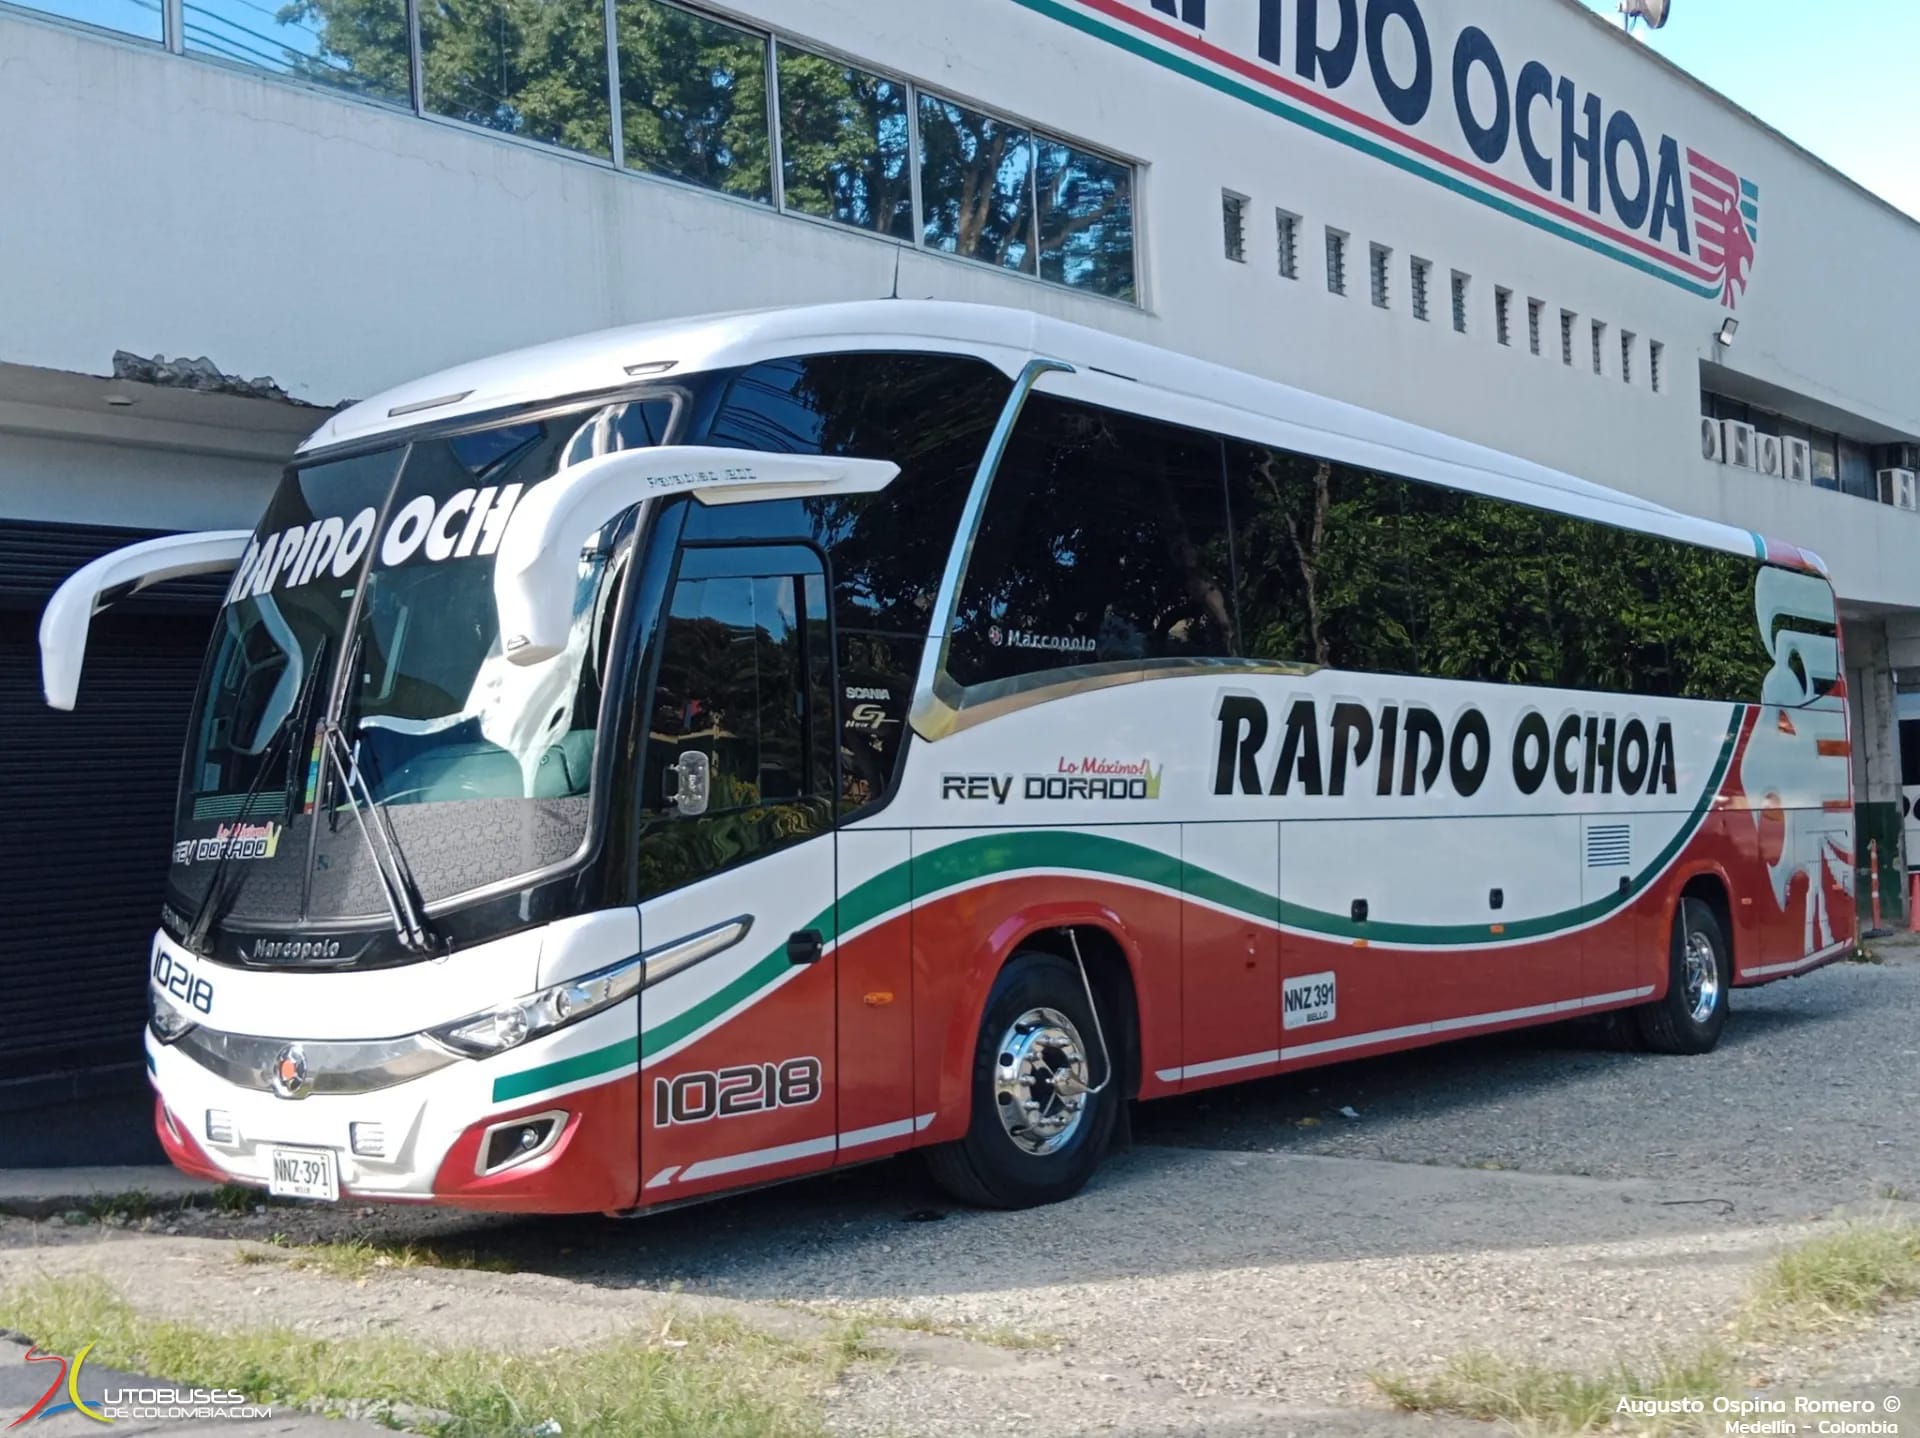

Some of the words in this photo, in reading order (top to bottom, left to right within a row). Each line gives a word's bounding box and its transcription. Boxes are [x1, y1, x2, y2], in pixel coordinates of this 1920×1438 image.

[1451, 26, 1691, 257] OCHOA
[222, 507, 377, 607] RAPIDO
[381, 483, 524, 567] OCH
[1007, 629, 1097, 652] Marcopolo
[845, 686, 891, 700] SCANIA
[1213, 694, 1491, 798] RAPIDO
[1512, 710, 1678, 796] OCHOA
[1057, 756, 1077, 774] Lo
[942, 774, 1014, 805] REY
[1024, 776, 1148, 800] DORADO
[253, 938, 341, 959] Marcopolo
[152, 946, 214, 1015] 10218
[1284, 986, 1312, 1013] NNZ
[1313, 982, 1334, 1008] 391
[653, 1055, 822, 1129] 10218
